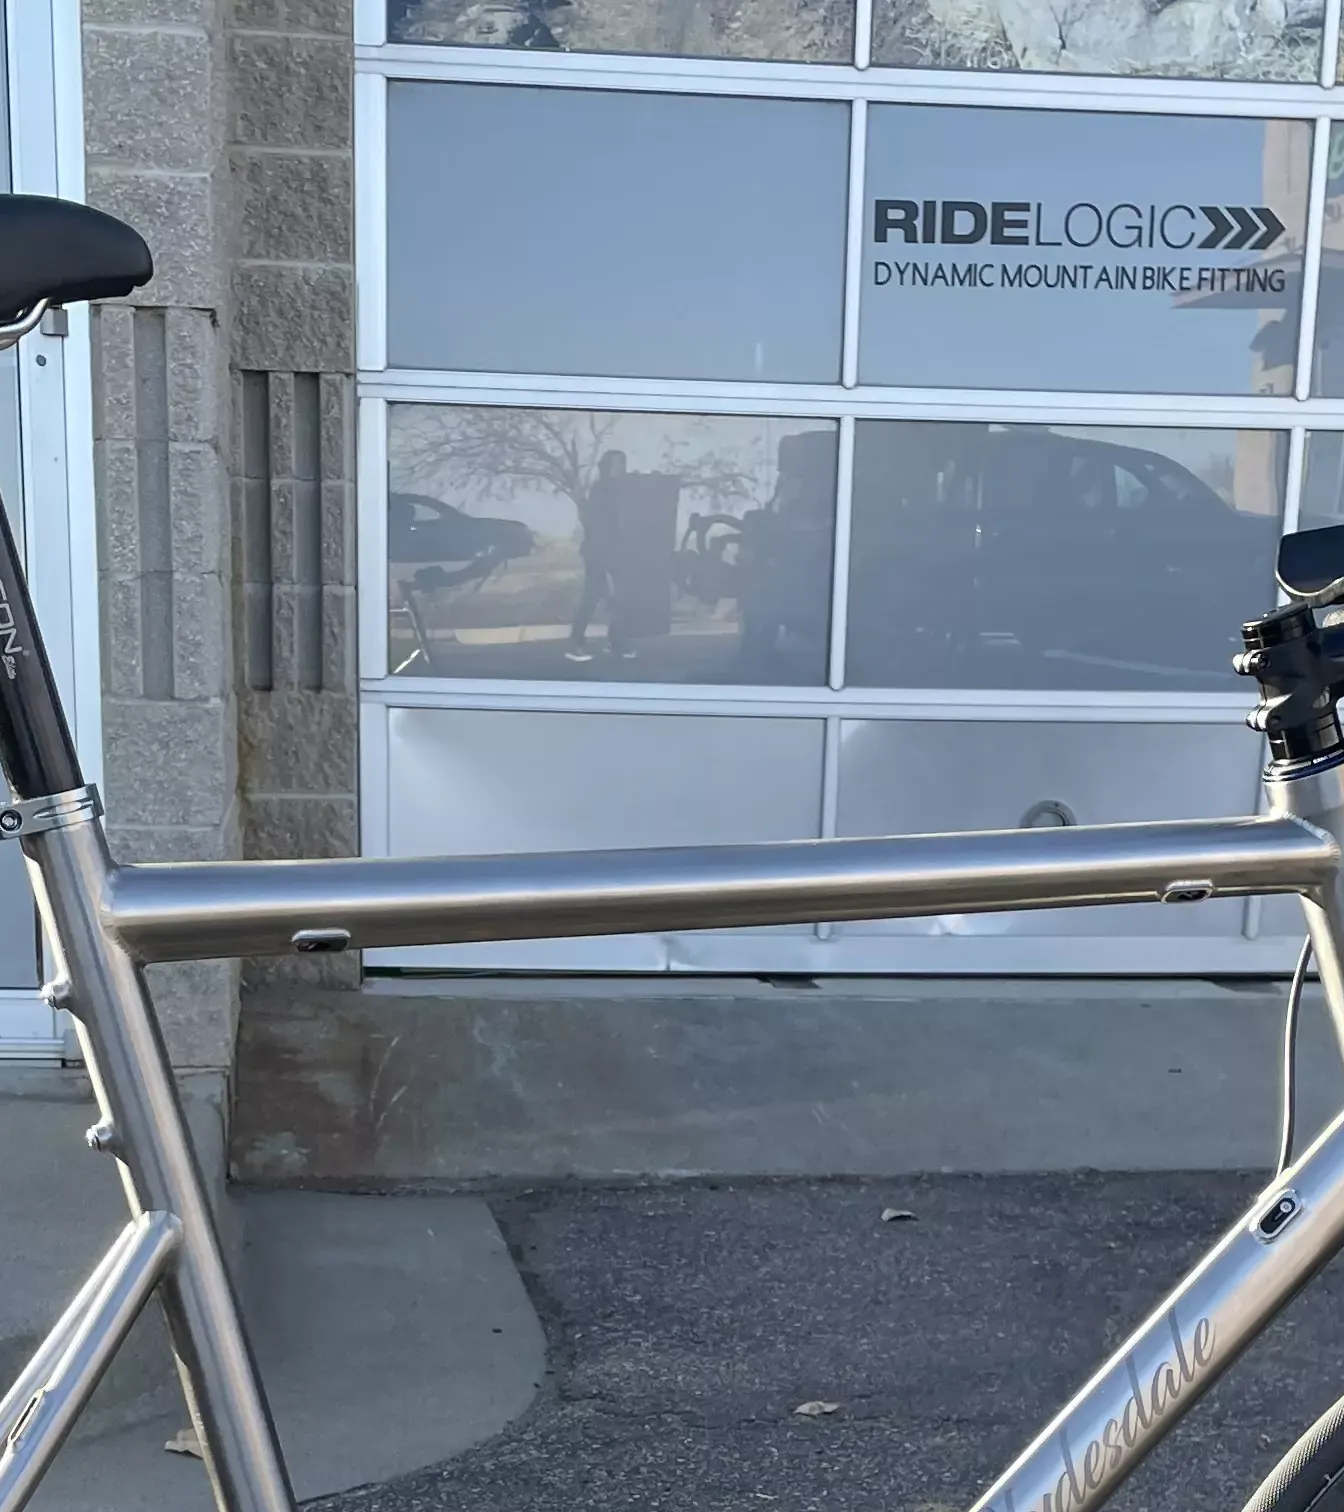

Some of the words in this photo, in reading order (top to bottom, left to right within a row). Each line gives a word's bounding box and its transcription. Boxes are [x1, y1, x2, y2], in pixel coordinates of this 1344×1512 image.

[873, 261, 995, 288] DYNAMIC
[1001, 264, 1138, 291] MOUNTAIN
[1142, 266, 1192, 291] BIKE
[1197, 267, 1287, 292] FITTING
